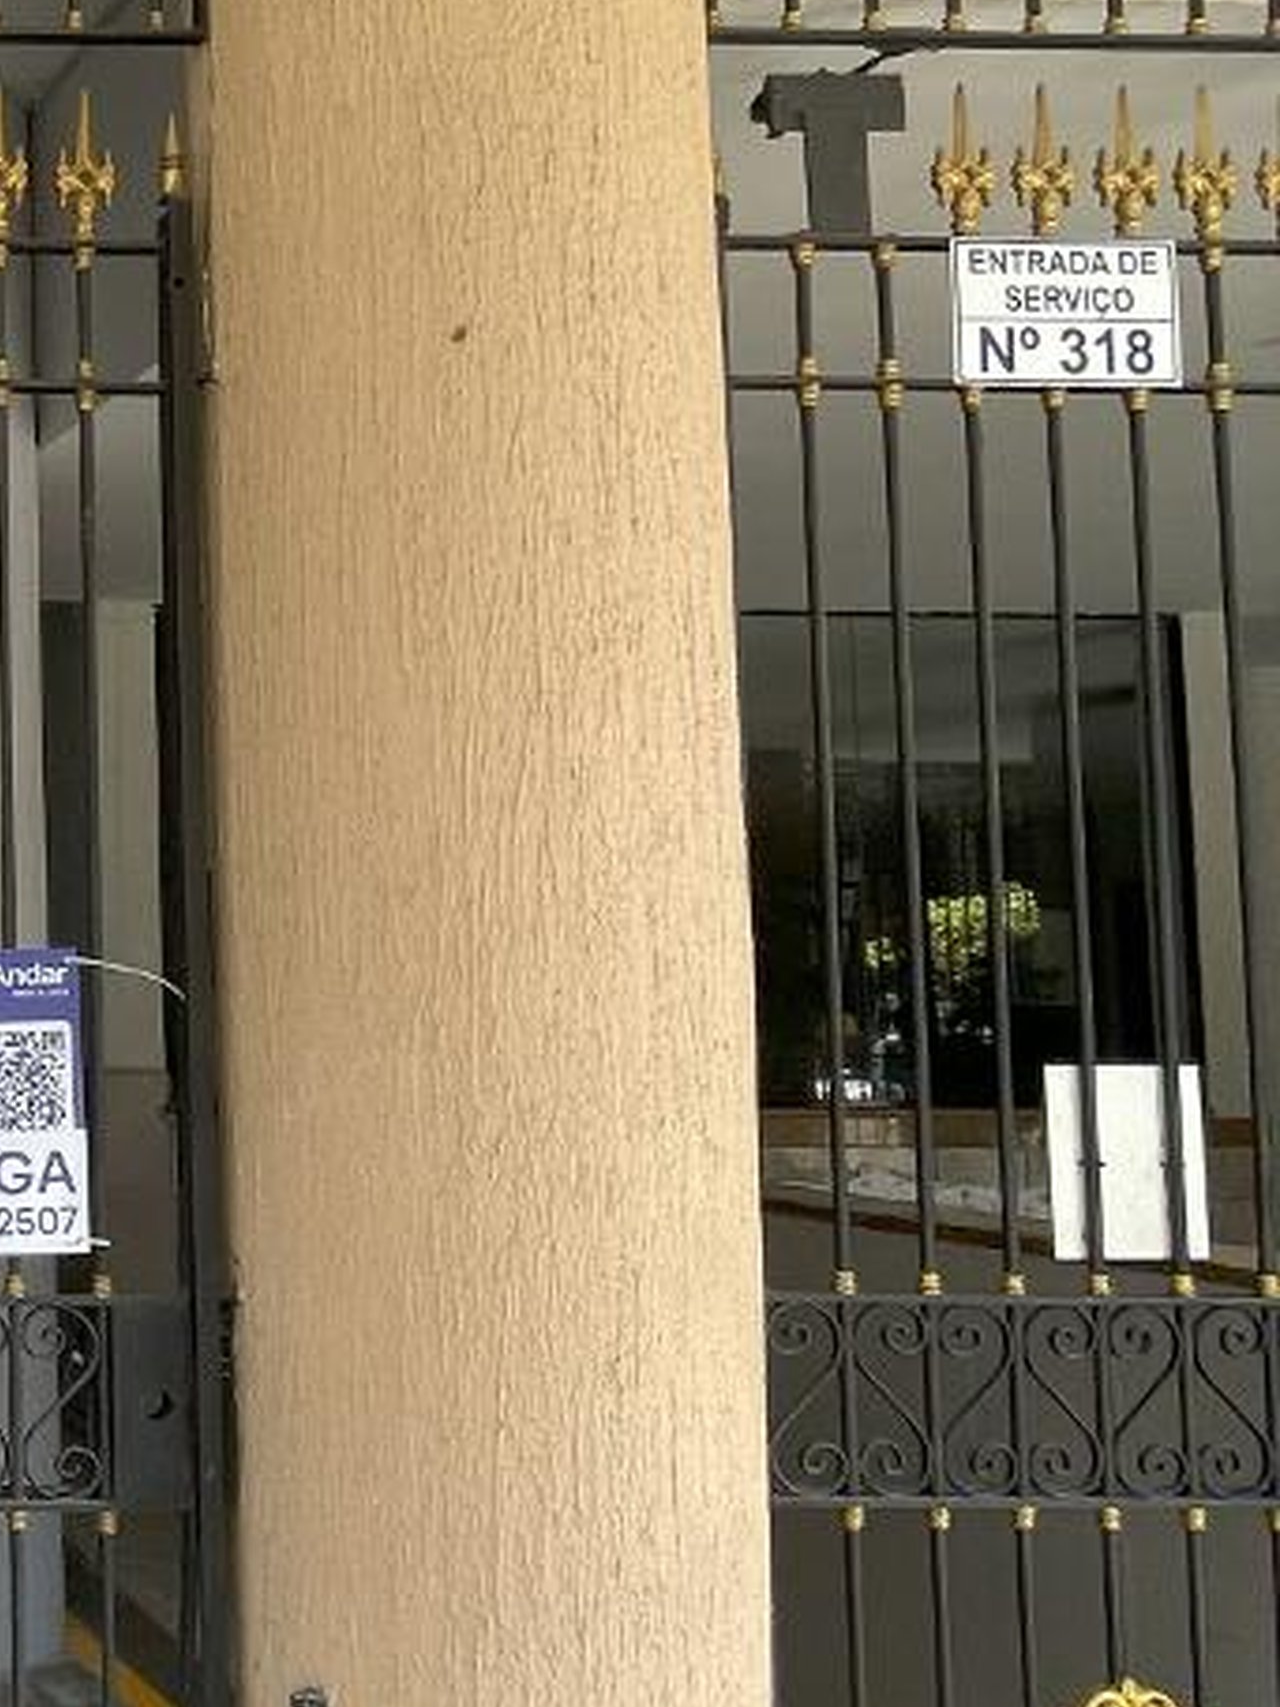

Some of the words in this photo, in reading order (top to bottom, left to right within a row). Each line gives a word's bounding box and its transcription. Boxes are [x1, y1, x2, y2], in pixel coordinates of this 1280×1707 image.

[968, 248, 1111, 275] ENTRADA
[1118, 250, 1158, 275] DE
[1005, 285, 1135, 316] SERVIÇO
[1059, 327, 1155, 375] 318
